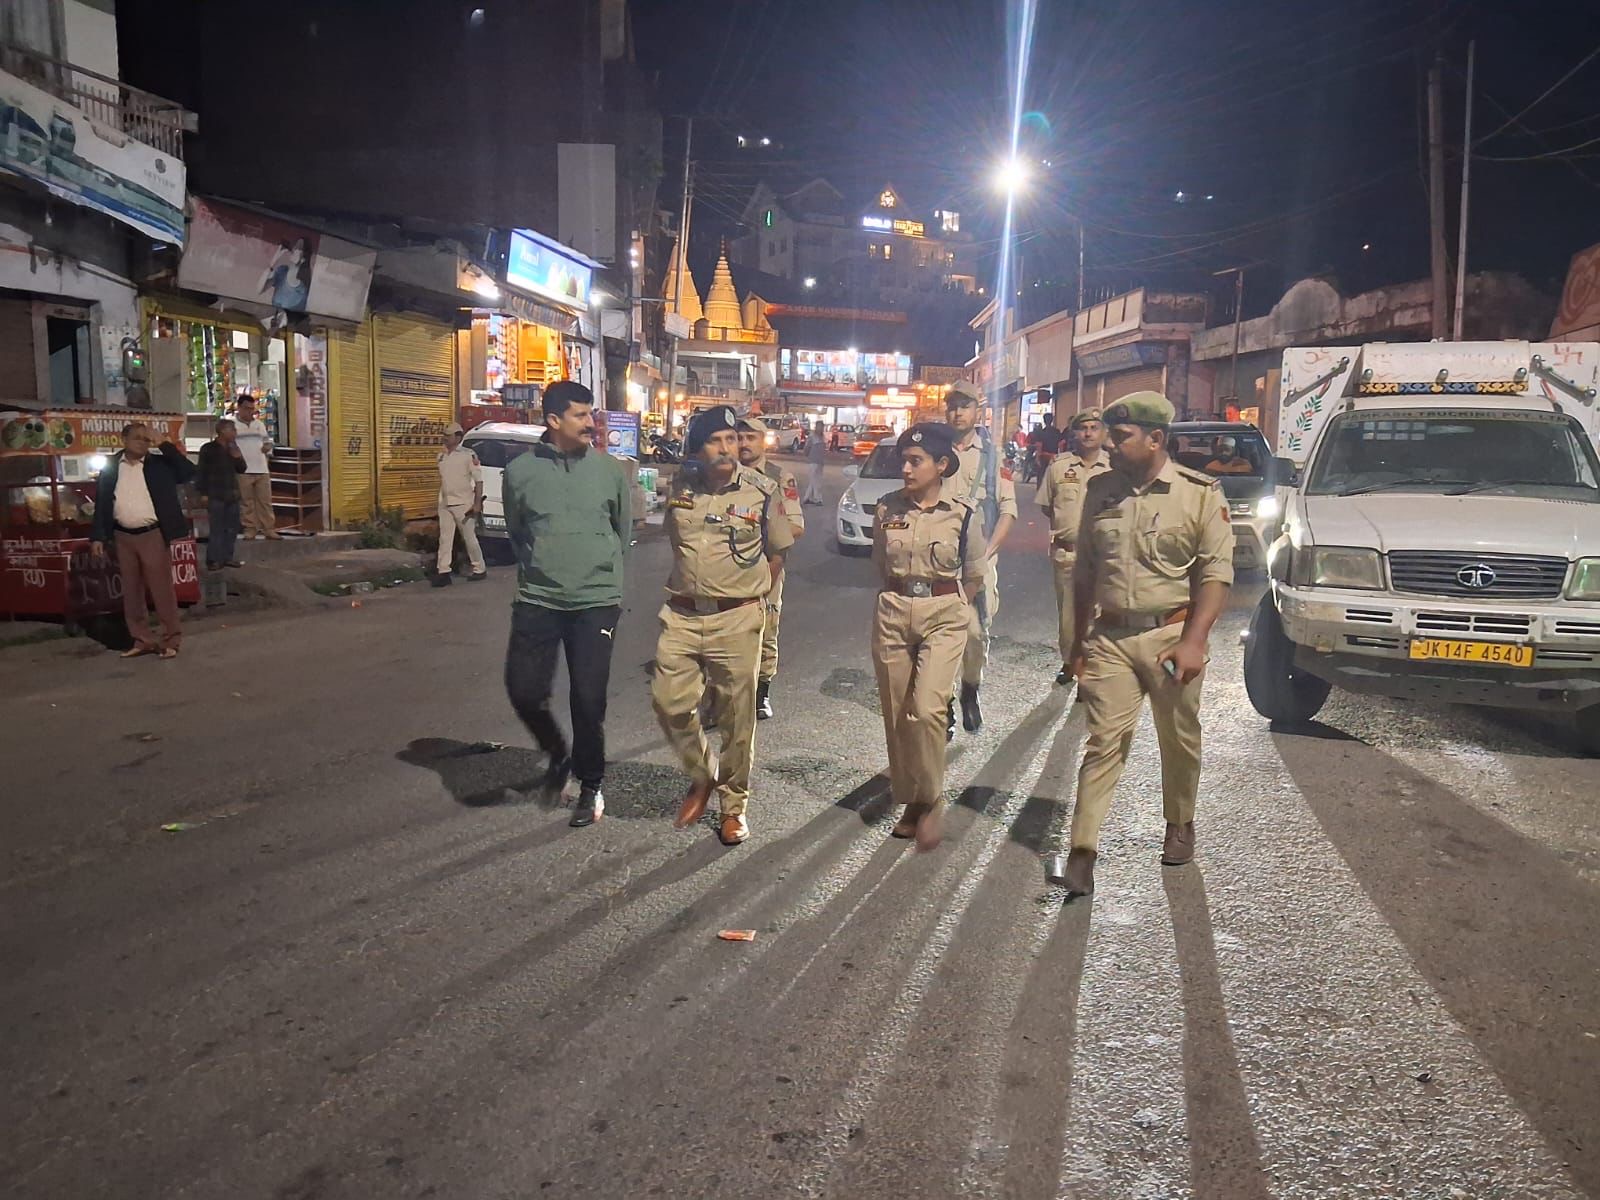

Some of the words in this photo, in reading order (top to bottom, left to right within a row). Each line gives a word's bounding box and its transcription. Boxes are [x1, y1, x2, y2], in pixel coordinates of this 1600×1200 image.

[309, 350, 326, 436] BARBER
[1417, 410, 1497, 418] TRUCKING
[170, 543, 196, 562] LCHA
[1421, 641, 1473, 659] JK14F
[1481, 645, 1523, 663] 4540
